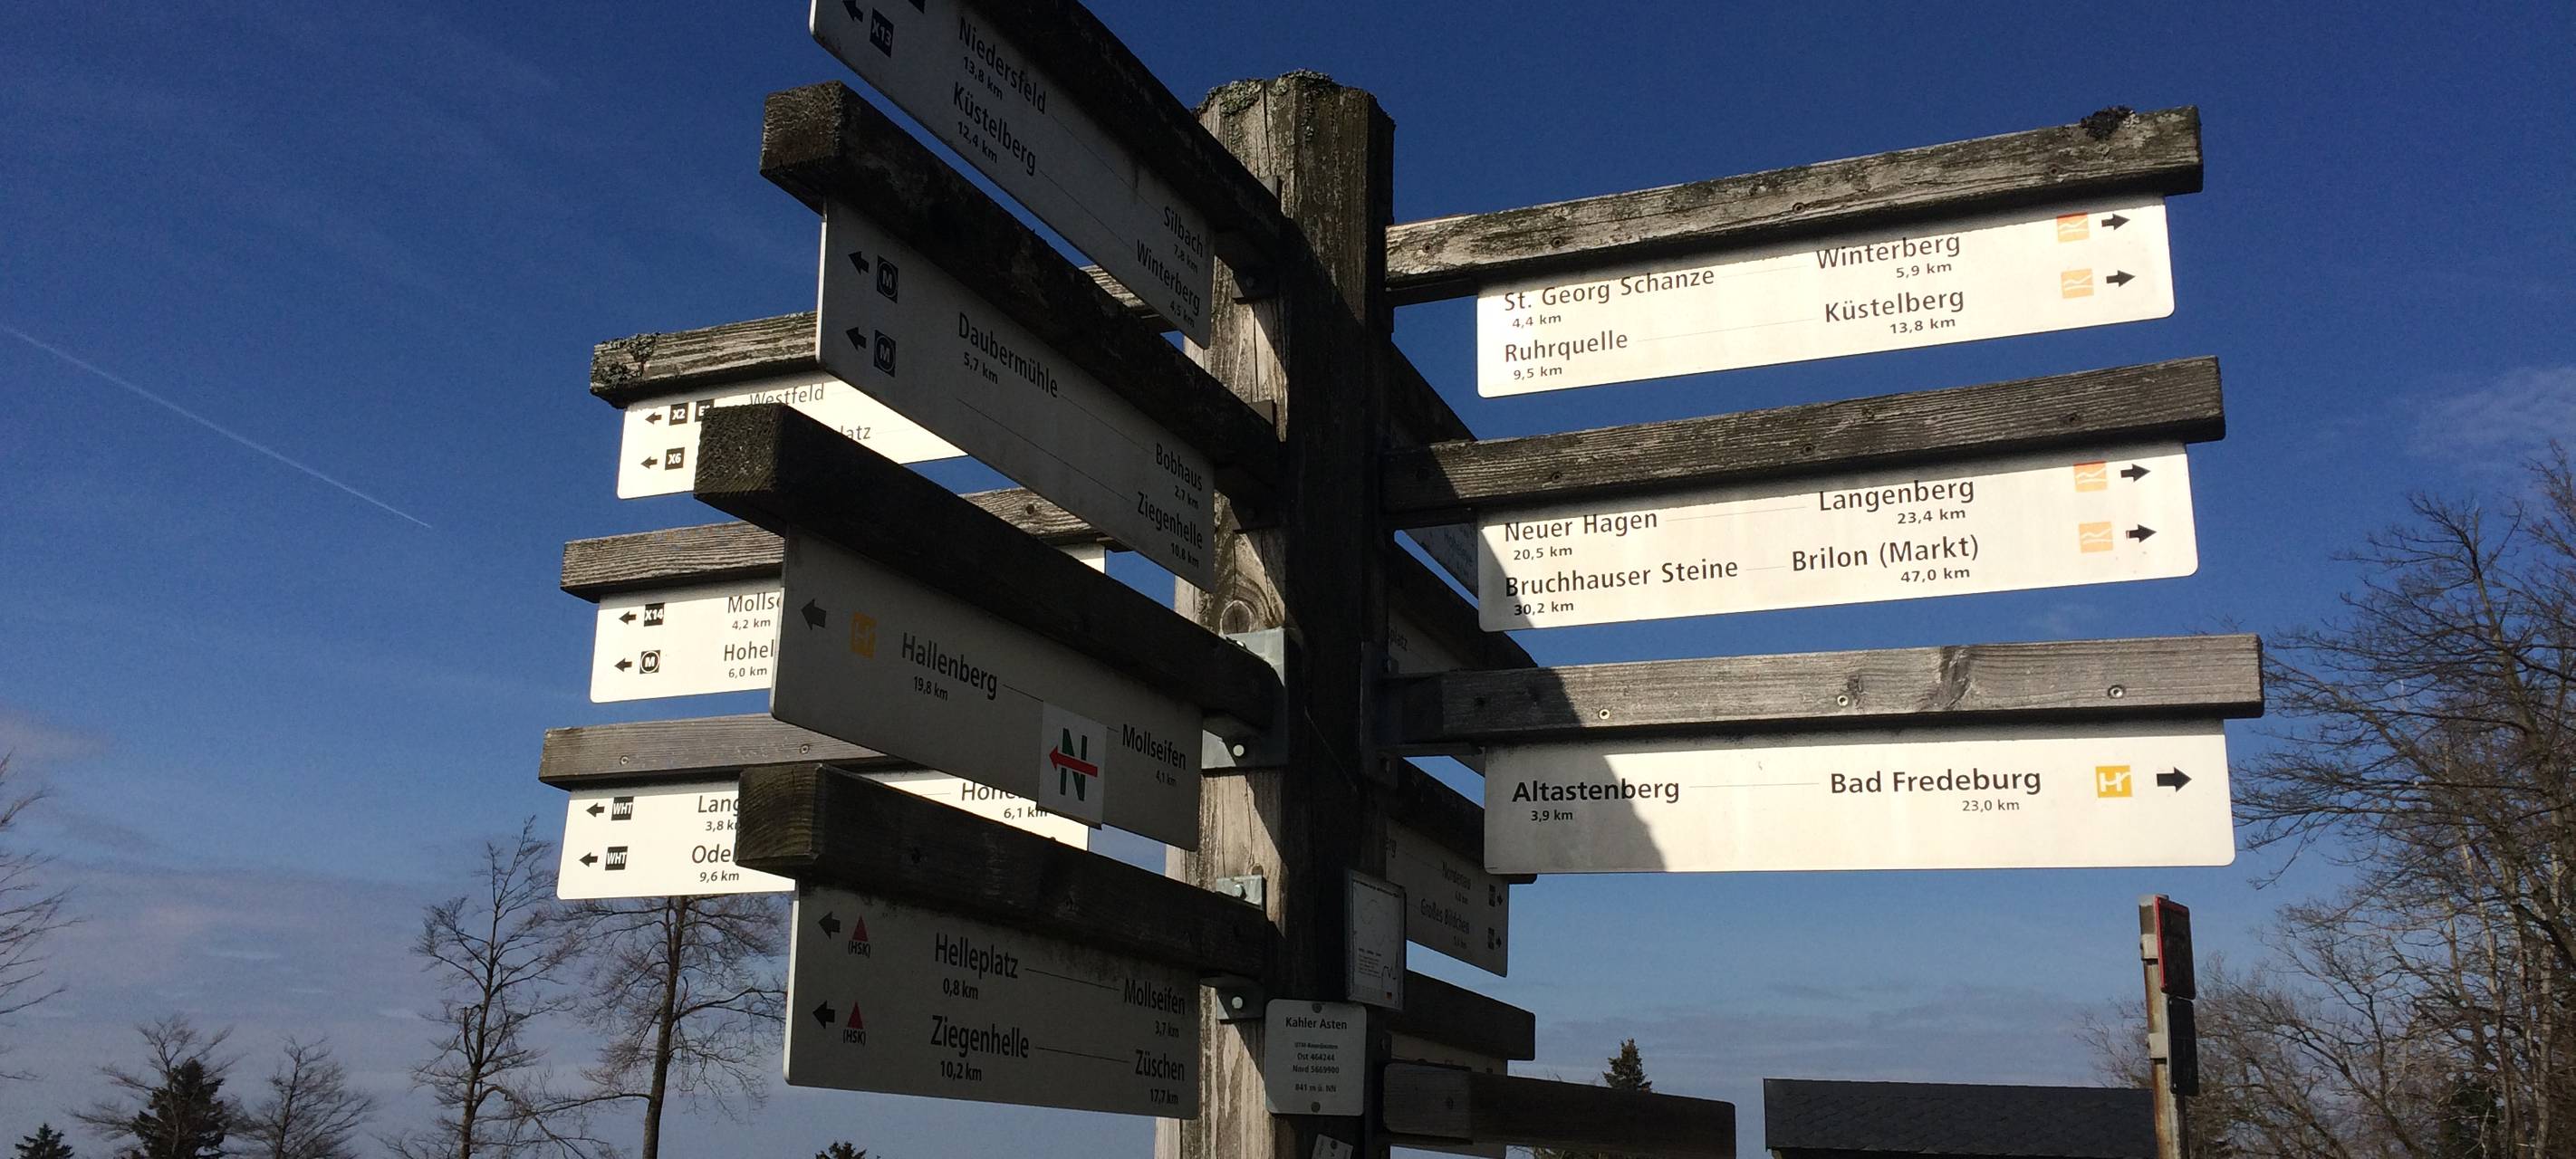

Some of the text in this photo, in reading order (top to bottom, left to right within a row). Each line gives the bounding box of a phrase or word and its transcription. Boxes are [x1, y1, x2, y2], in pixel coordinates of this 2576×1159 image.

[871, 21, 891, 44] X13
[959, 16, 1046, 115] Niedersfeld
[964, 56, 1003, 101] 13,8 km
[953, 81, 1036, 177] Küstelberg
[958, 121, 997, 164] 12,4 km
[1164, 206, 1203, 258] Silbach
[1817, 235, 1961, 269] Winterberg
[1137, 239, 1200, 315] Winterberg
[1896, 262, 1952, 280] 5,9 km
[1504, 269, 1715, 311] St. Georg Schanze
[1825, 289, 1964, 322] Küstelberg
[1512, 314, 1562, 328] 4,4 km
[1890, 317, 1956, 335] 13,8 km
[959, 311, 1058, 398] Daubermühle
[1504, 330, 1628, 362] Ruhrquelle
[964, 351, 997, 384] 5,7 km
[1514, 366, 1562, 380] 9,5 km
[750, 382, 824, 405] Westfeld
[672, 408, 685, 420] X2
[1156, 443, 1203, 491] Bobhaus
[1819, 478, 1975, 513] Langenberg
[1138, 491, 1203, 550] Ziegenhelle
[1504, 512, 1658, 541] Neuer Hagen
[1897, 507, 1966, 525] 23,4 km
[1514, 545, 1573, 560] 20,5 km
[1792, 534, 1979, 572] Brilon (Markt)
[1505, 558, 1738, 597] Bruchhauser Steine
[1900, 566, 1970, 584] 47,0 km
[645, 608, 664, 621] X14
[727, 592, 780, 613] Molls
[1514, 600, 1574, 616] 30,2 km
[732, 618, 771, 629] 4,2 km
[728, 666, 767, 679] 6,0 km
[901, 632, 998, 700] Hallenberg
[913, 675, 948, 701] 19,8 km
[1122, 724, 1187, 770] Mollseifen
[1512, 778, 1679, 804] Altastenberg
[1831, 768, 2042, 796] Bad Fredeburg
[612, 802, 632, 814] WHT
[1004, 808, 1022, 819] 6,1
[1531, 809, 1573, 822] 3,9 km
[1962, 799, 2020, 813] 23,0 km
[706, 820, 723, 831] 3,8
[606, 852, 627, 865] WHT
[699, 870, 739, 883] 9,6 km
[848, 941, 870, 958] (HSK)
[935, 933, 1018, 979] Helleplatz
[943, 979, 978, 1000] 0,8 km
[1124, 979, 1186, 1014] Mollseifen
[1285, 1017, 1347, 1030] Kahler Asten
[842, 1029, 866, 1044] (HSK)
[930, 1015, 1030, 1058] Ziegenhelle
[940, 1060, 982, 1080] 10,2 km
[1135, 1049, 1186, 1081] Züschen
